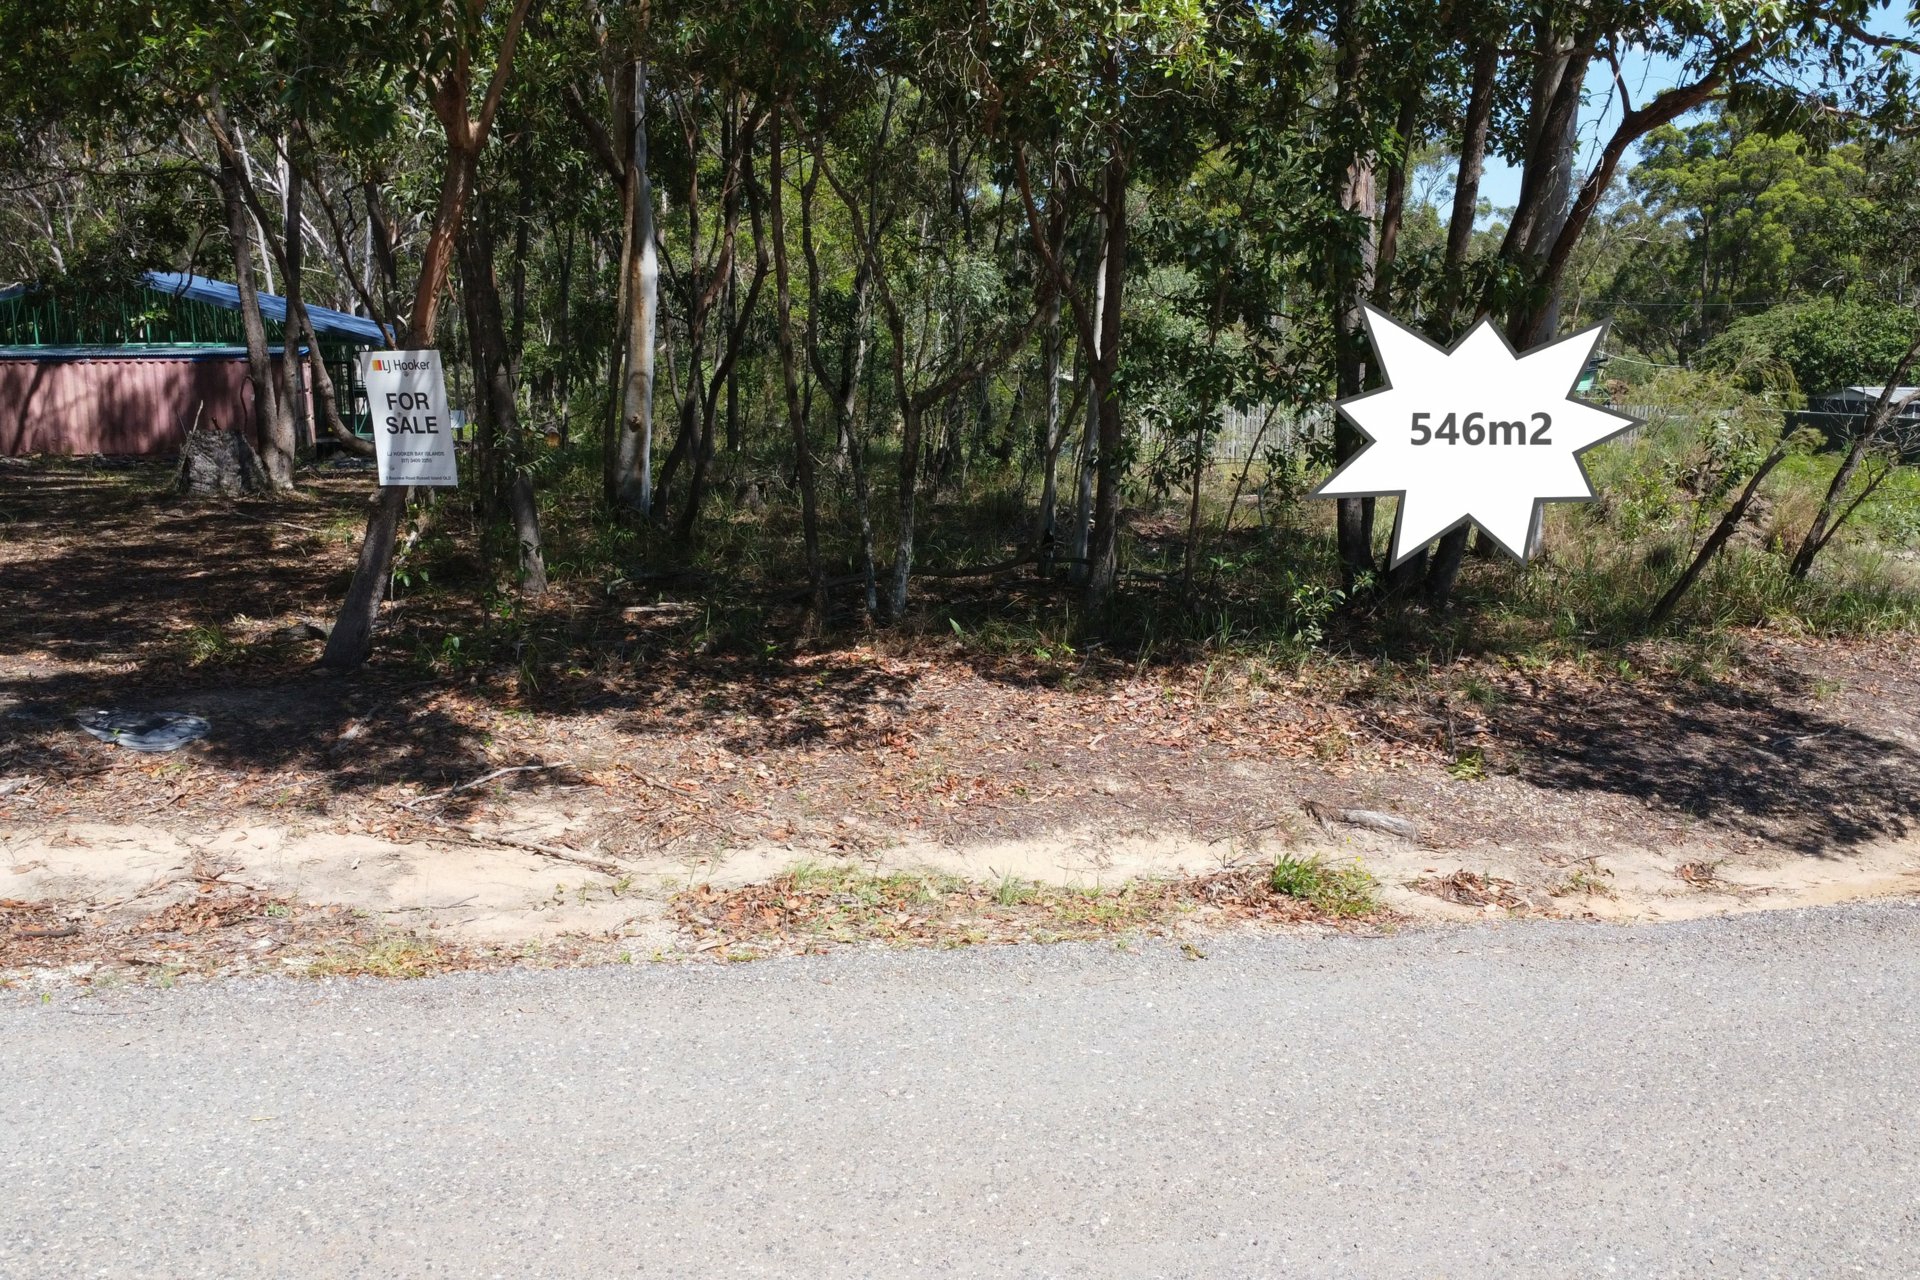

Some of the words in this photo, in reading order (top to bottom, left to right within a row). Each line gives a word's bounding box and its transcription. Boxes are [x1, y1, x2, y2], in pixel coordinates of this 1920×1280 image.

[382, 359, 392, 373] LJ
[394, 359, 430, 371] Hooker
[386, 392, 430, 411] FOR
[386, 416, 439, 435] SALE
